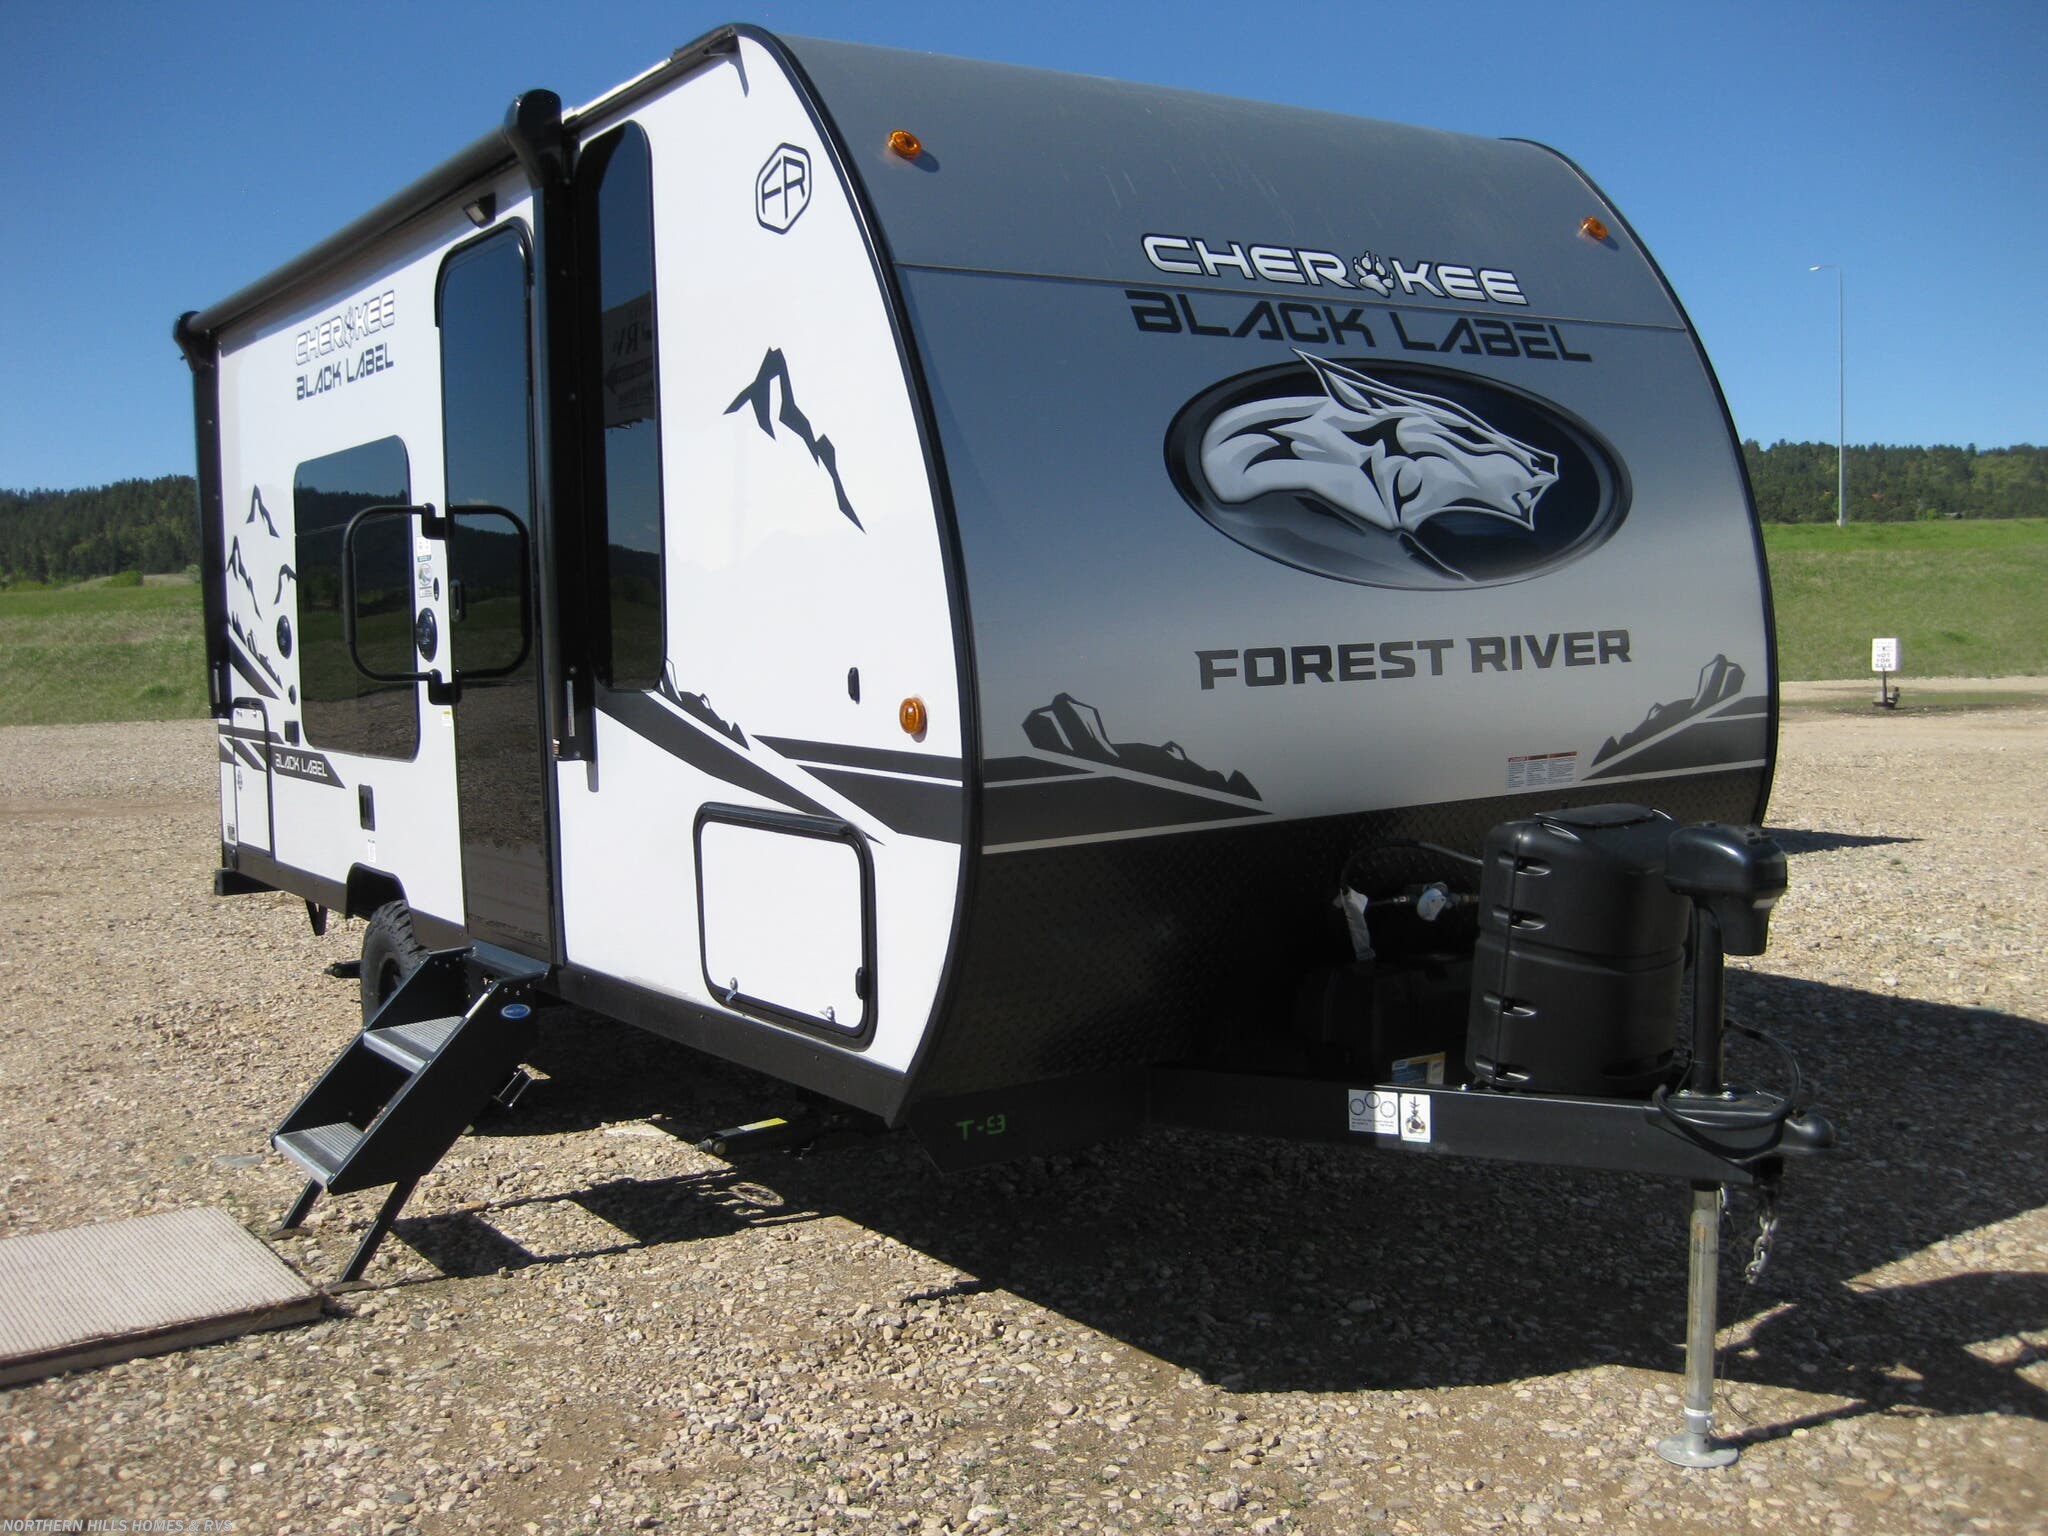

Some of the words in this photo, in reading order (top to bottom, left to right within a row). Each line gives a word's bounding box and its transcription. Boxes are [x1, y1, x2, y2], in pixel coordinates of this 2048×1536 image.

[1124, 290, 1376, 347] BLACK
[1388, 311, 1592, 362] LABEL
[296, 360, 342, 400] BLACK
[346, 342, 394, 383] LABEL
[1194, 638, 1455, 690] FOREST
[1465, 629, 1633, 674] RIVER
[275, 753, 300, 772] BLACK
[301, 758, 328, 778] LABEL
